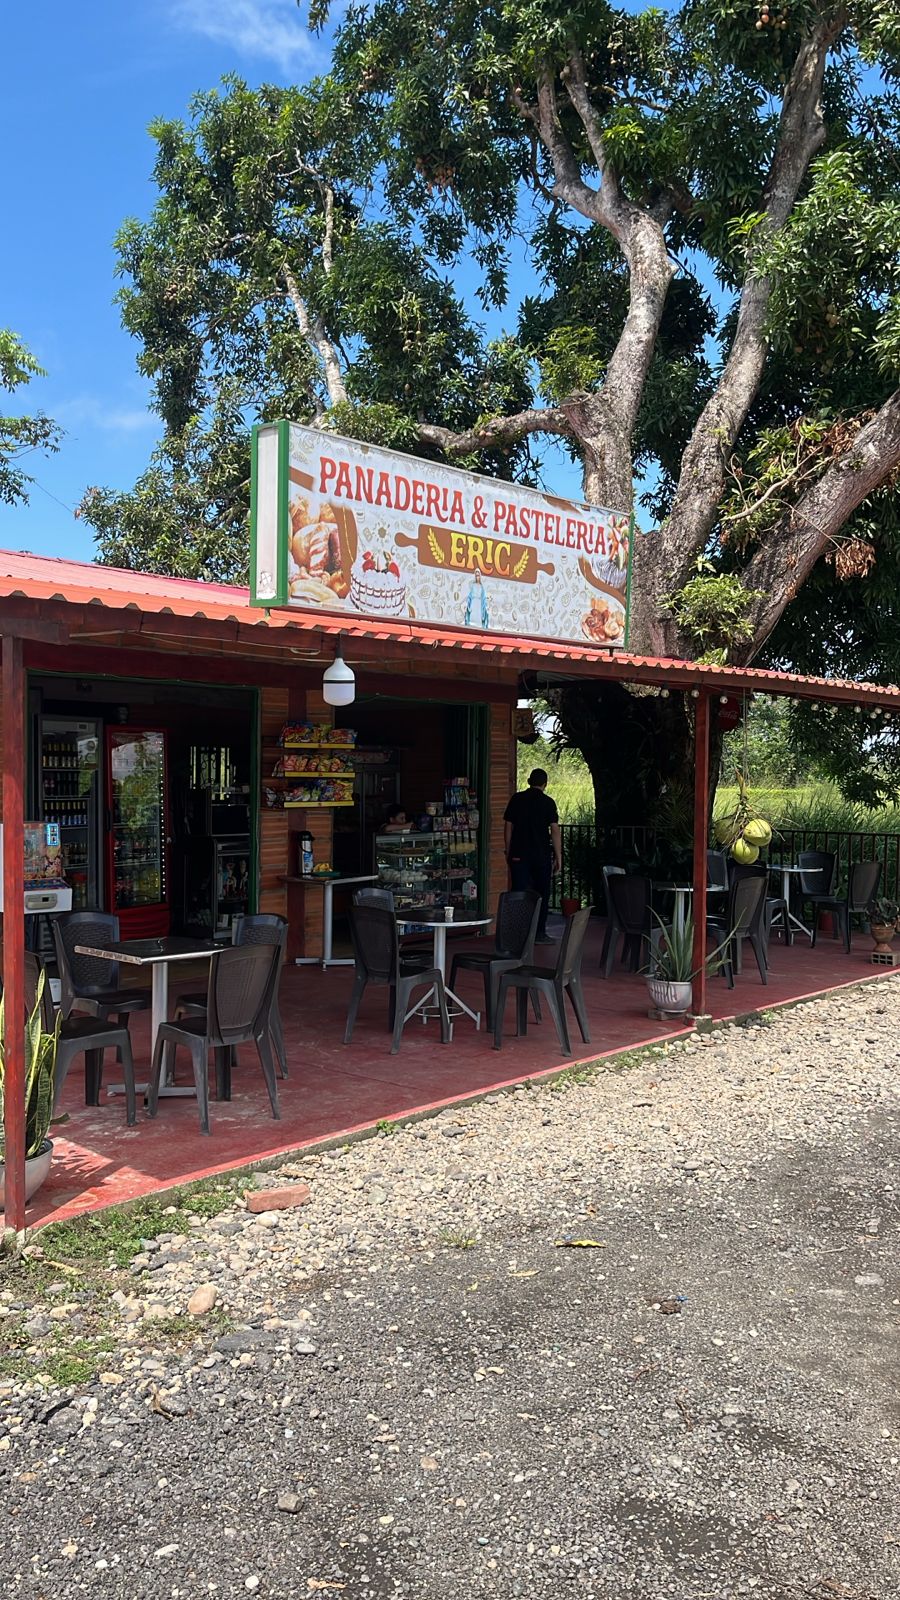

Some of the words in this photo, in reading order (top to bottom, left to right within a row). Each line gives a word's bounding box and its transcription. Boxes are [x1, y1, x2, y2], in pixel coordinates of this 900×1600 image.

[319, 456, 465, 525] PANADERIA
[471, 495, 488, 529] &
[493, 500, 607, 555] PASTELERIA
[450, 532, 512, 577] ERIC
